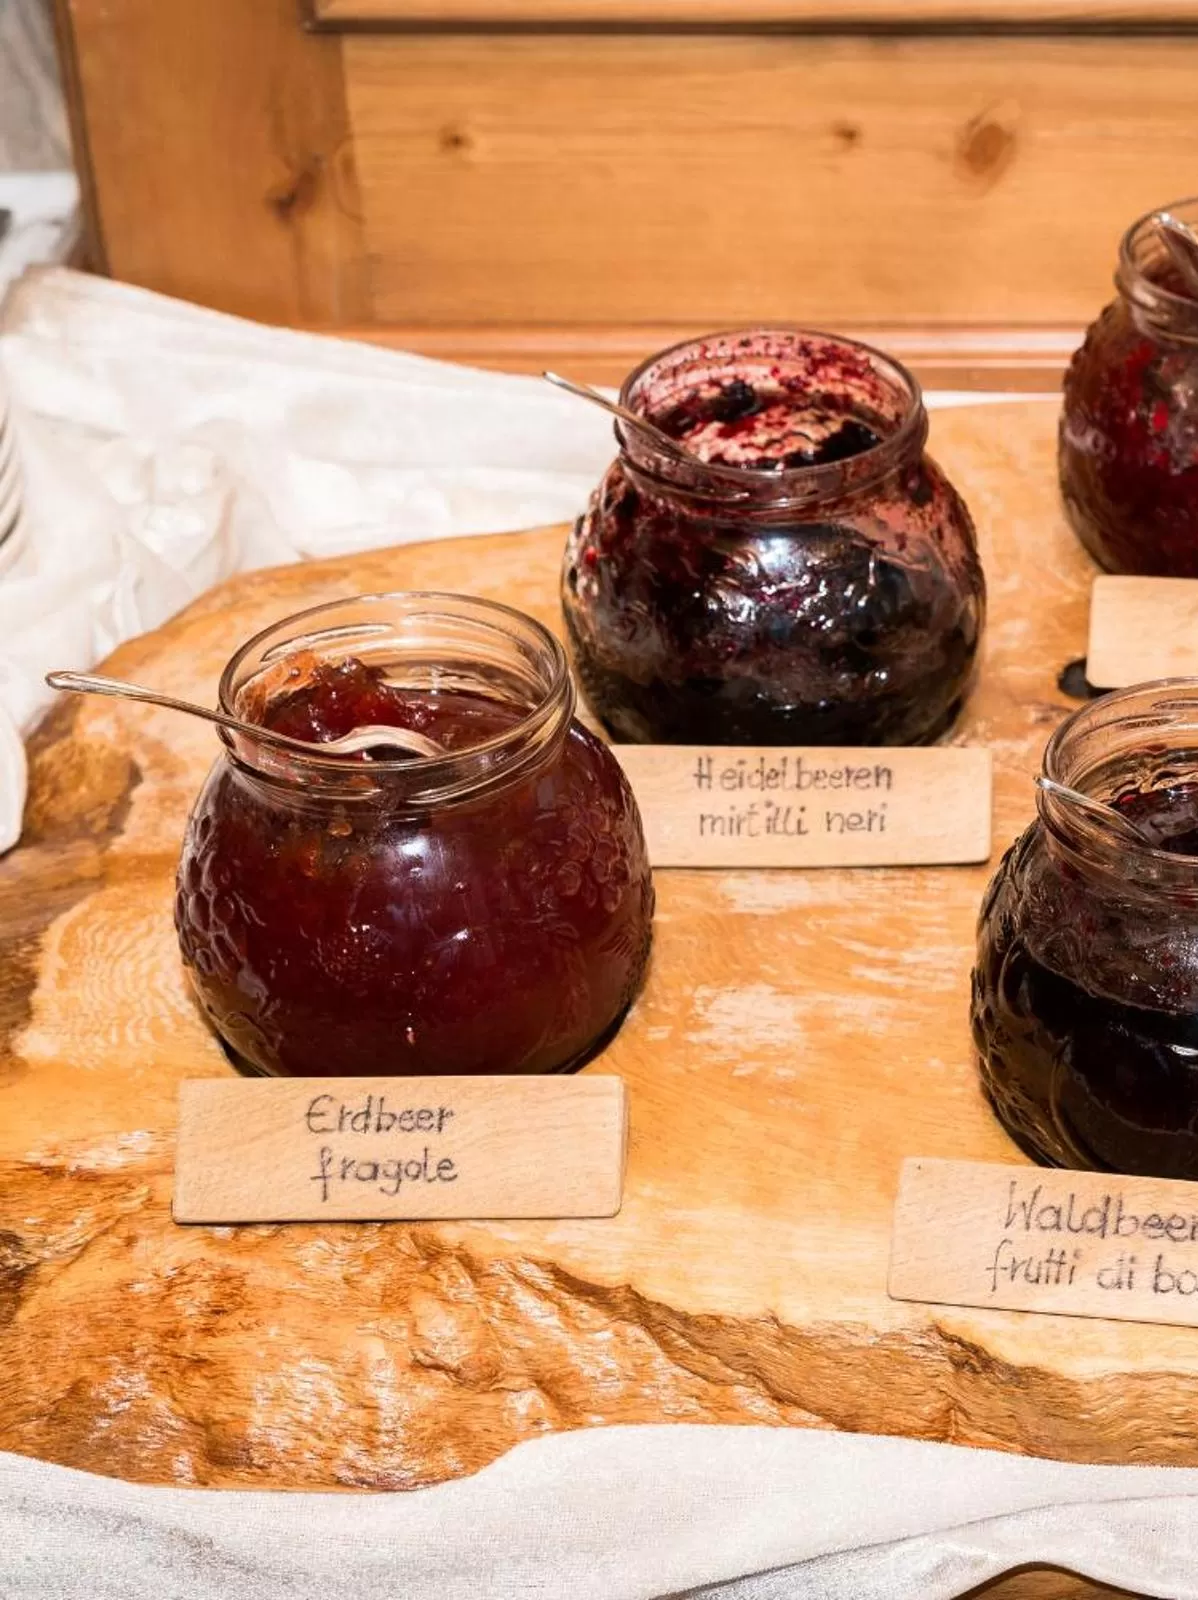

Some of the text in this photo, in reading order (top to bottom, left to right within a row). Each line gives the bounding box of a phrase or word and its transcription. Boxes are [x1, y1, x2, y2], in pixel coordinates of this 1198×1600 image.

[693, 755, 893, 791] Heidelbeeren
[699, 801, 888, 837] mirtilli neri
[304, 1094, 455, 1134] Erdbeer
[310, 1146, 459, 1202] fragole
[986, 1238, 1082, 1292] frutti
[1096, 1248, 1136, 1291] di
